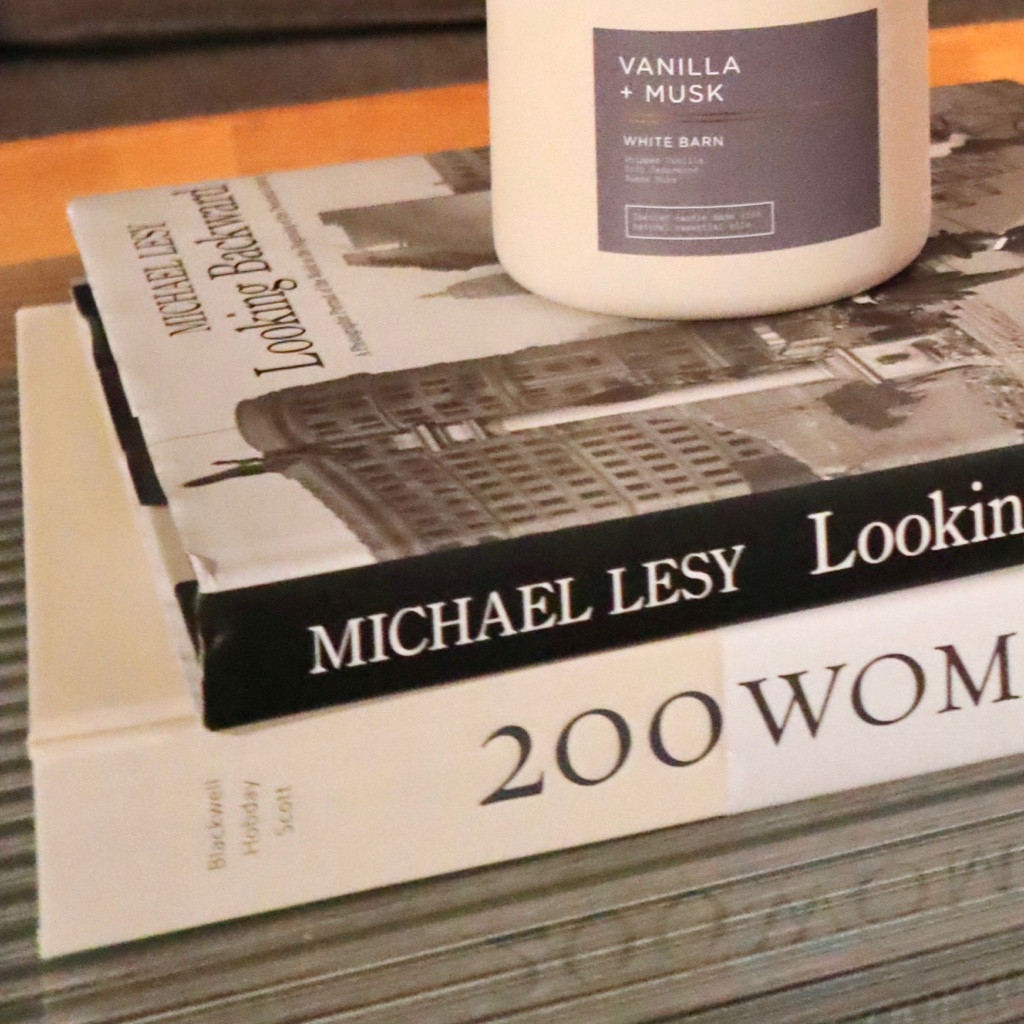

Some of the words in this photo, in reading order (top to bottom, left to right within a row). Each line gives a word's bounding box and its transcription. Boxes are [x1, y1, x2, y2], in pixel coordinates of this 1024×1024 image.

[618, 56, 741, 76] VANILLA
[620, 86, 633, 99] +
[645, 84, 724, 103] MUSK
[622, 136, 673, 148] WHITE
[679, 135, 724, 147] BARN
[127, 221, 178, 259] LESY
[143, 258, 212, 336] MICHAEL
[226, 279, 325, 377] Looking
[308, 577, 594, 675] MICHAEL
[607, 544, 747, 615] LESY
[479, 690, 723, 806] 200
[204, 779, 226, 870] Blackwell
